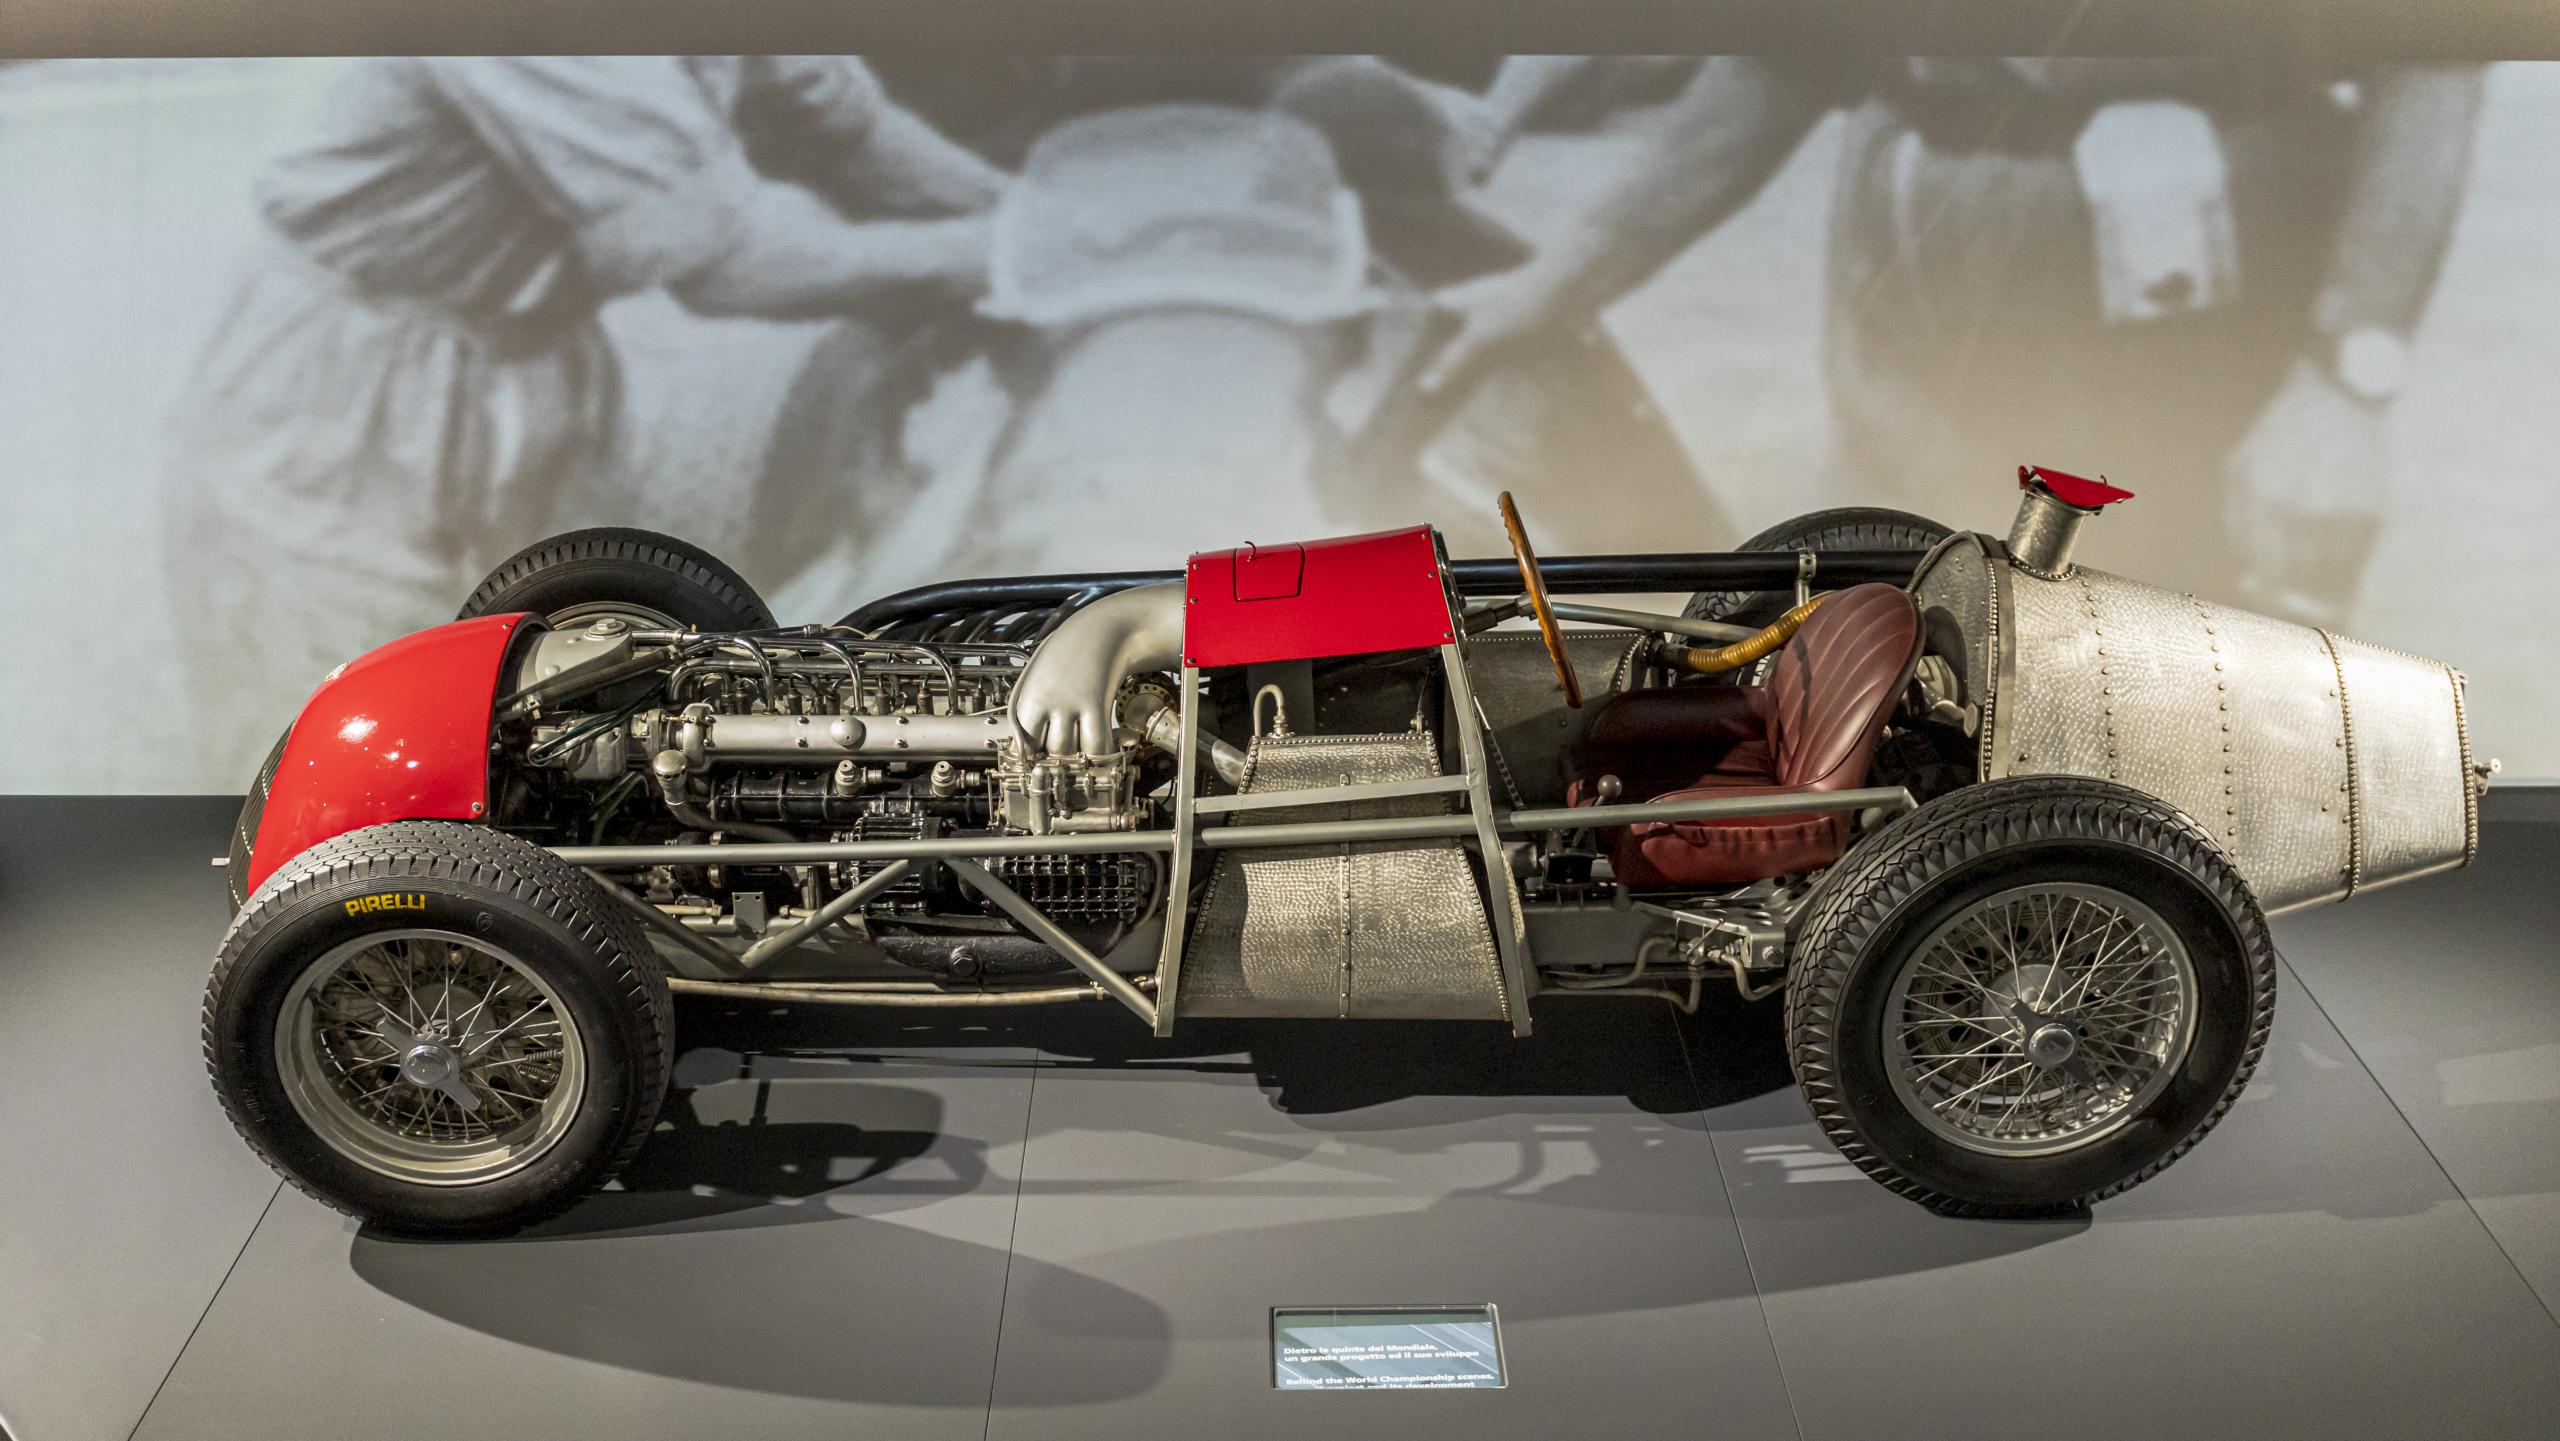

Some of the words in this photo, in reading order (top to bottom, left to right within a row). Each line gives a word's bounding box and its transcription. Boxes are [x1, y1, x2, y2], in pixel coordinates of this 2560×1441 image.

[344, 893, 426, 917] PIRELLI
[1300, 1354, 1337, 1362] grande
[1339, 1353, 1386, 1361] progetto
[1404, 1351, 1411, 1359] il
[1435, 1350, 1480, 1358] sviluppo
[1319, 1346, 1329, 1354] le
[1331, 1346, 1365, 1354] quinte
[1286, 1377, 1324, 1385] Behind
[1345, 1376, 1378, 1384] World
[1380, 1373, 1456, 1383] Championship
